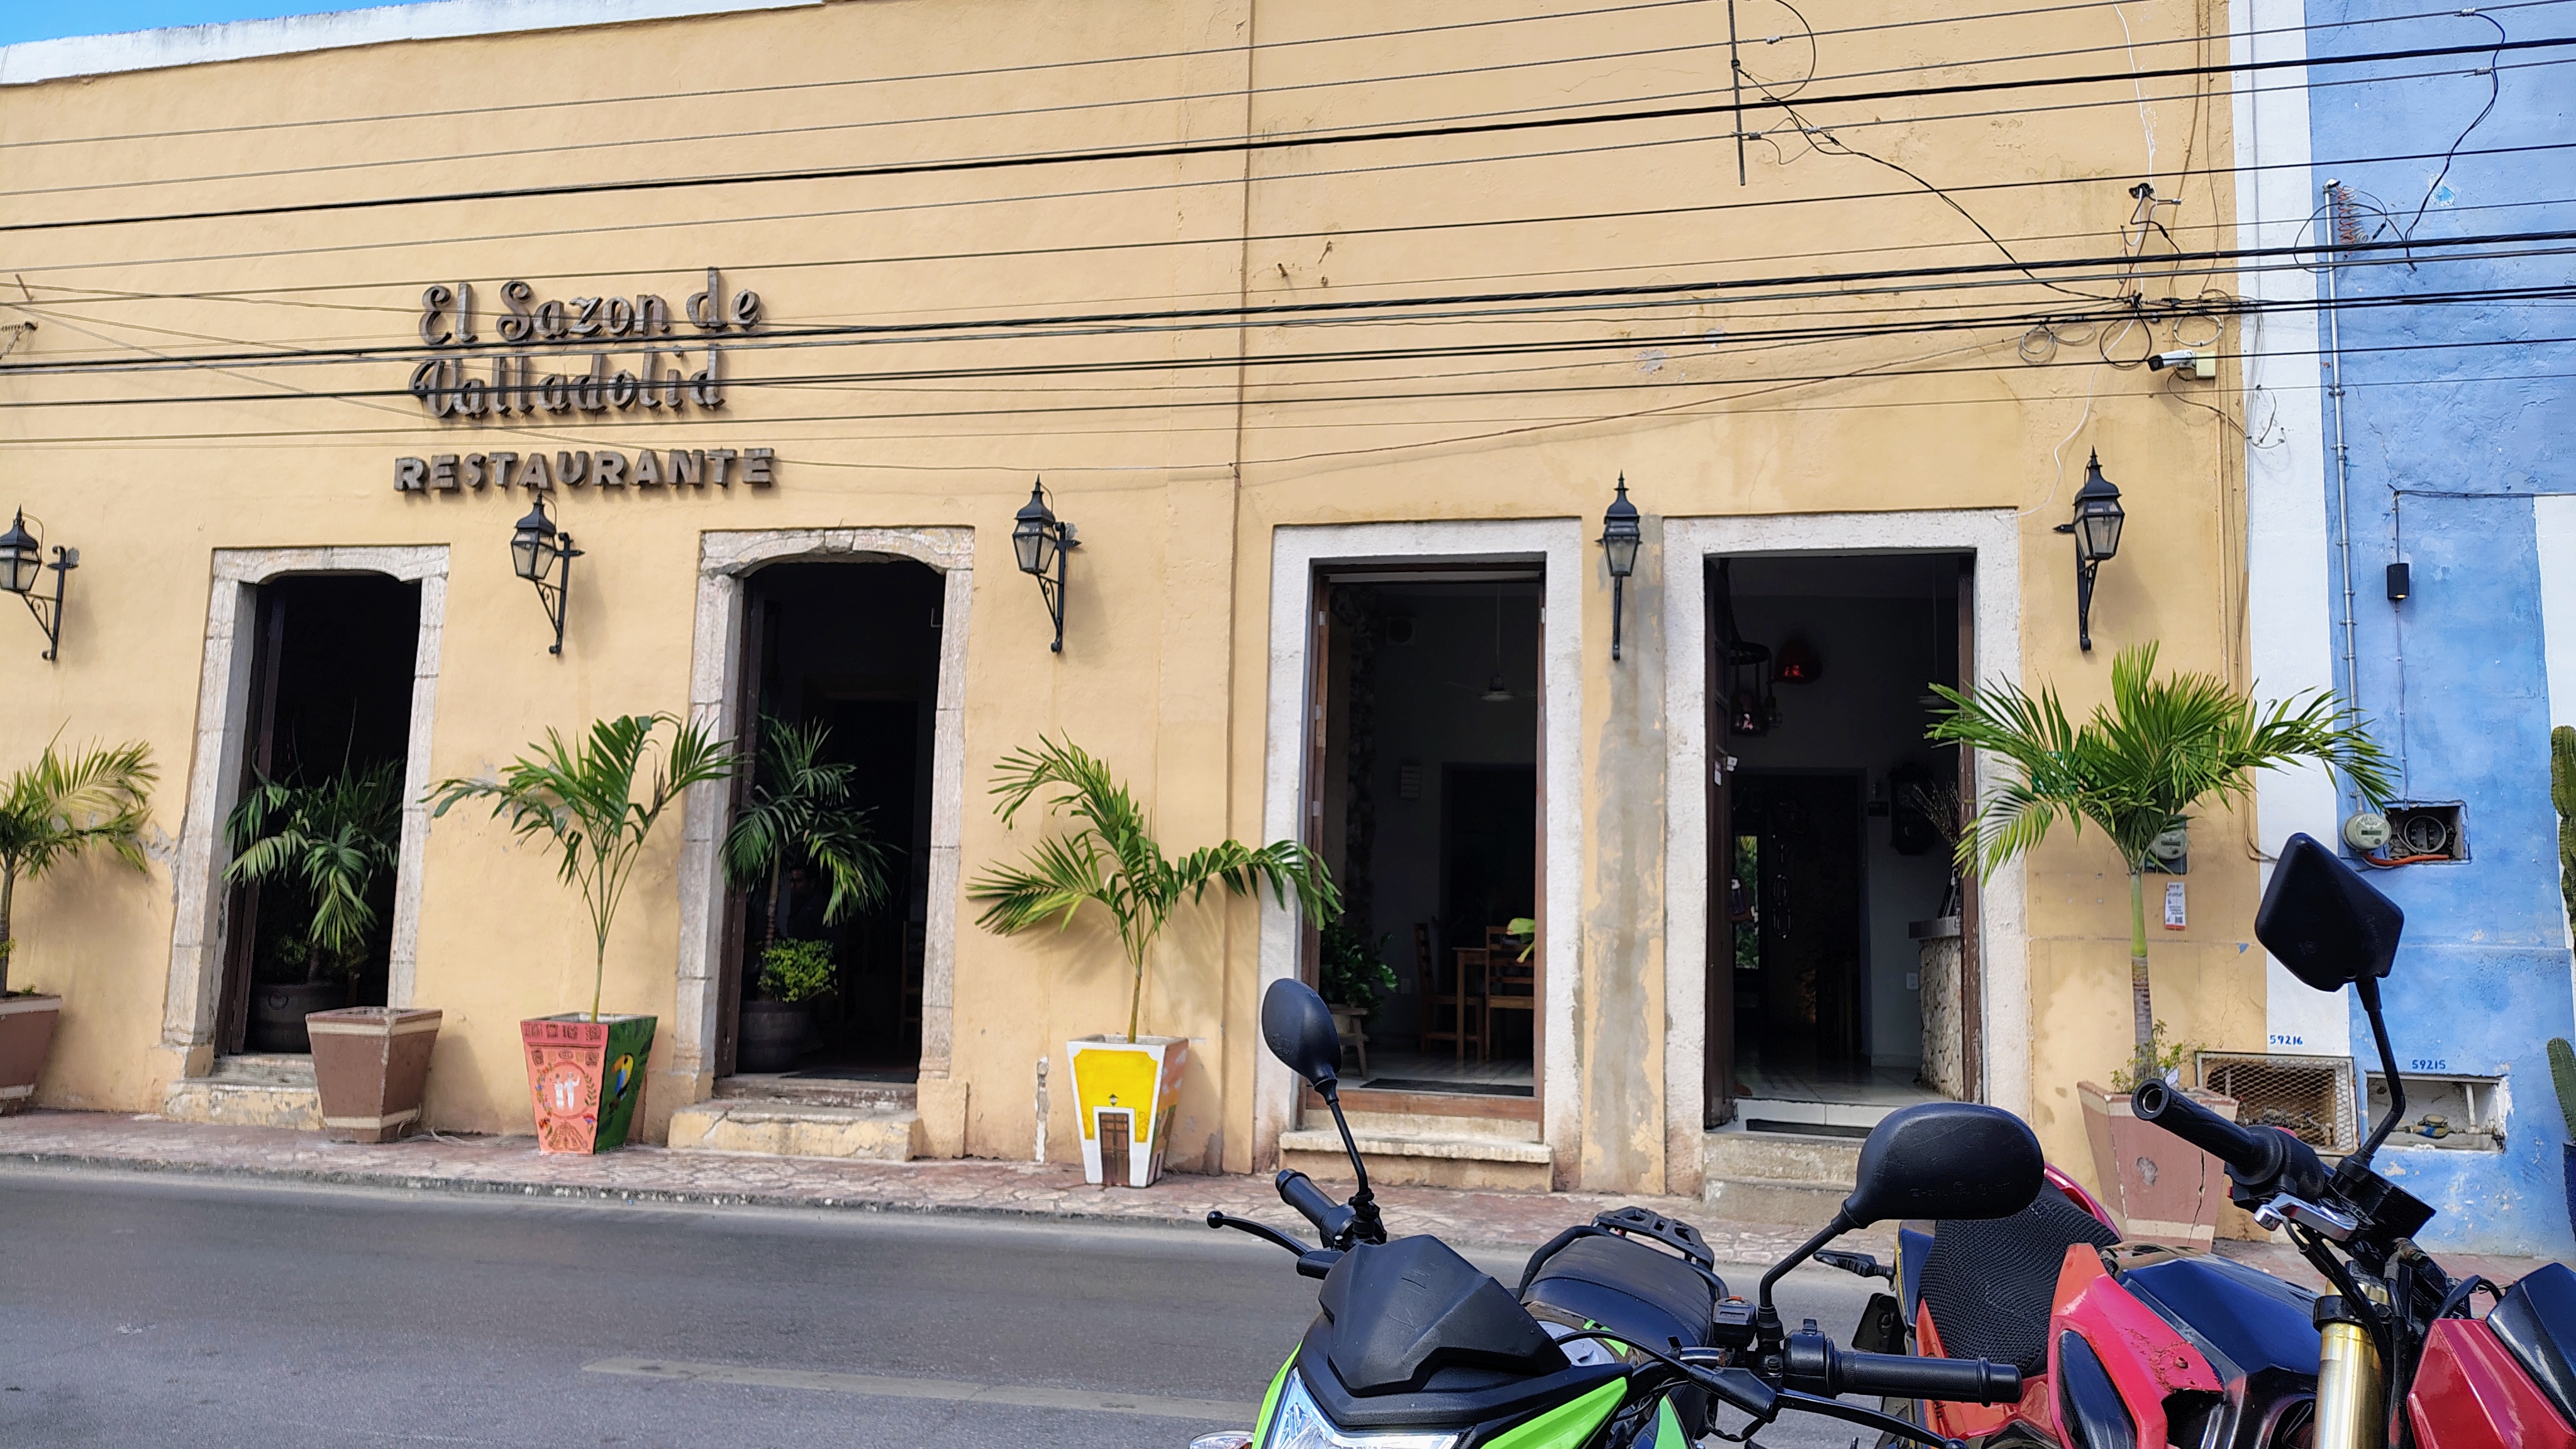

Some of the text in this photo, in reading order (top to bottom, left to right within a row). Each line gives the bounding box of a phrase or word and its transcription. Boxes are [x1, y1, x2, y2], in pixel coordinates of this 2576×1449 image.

[418, 267, 762, 345] El Sazon de
[409, 343, 725, 418] Valladolid
[394, 447, 777, 492] RESTAURANTE
[2269, 1035, 2304, 1045] 59216
[2412, 1059, 2446, 1070] 59215
